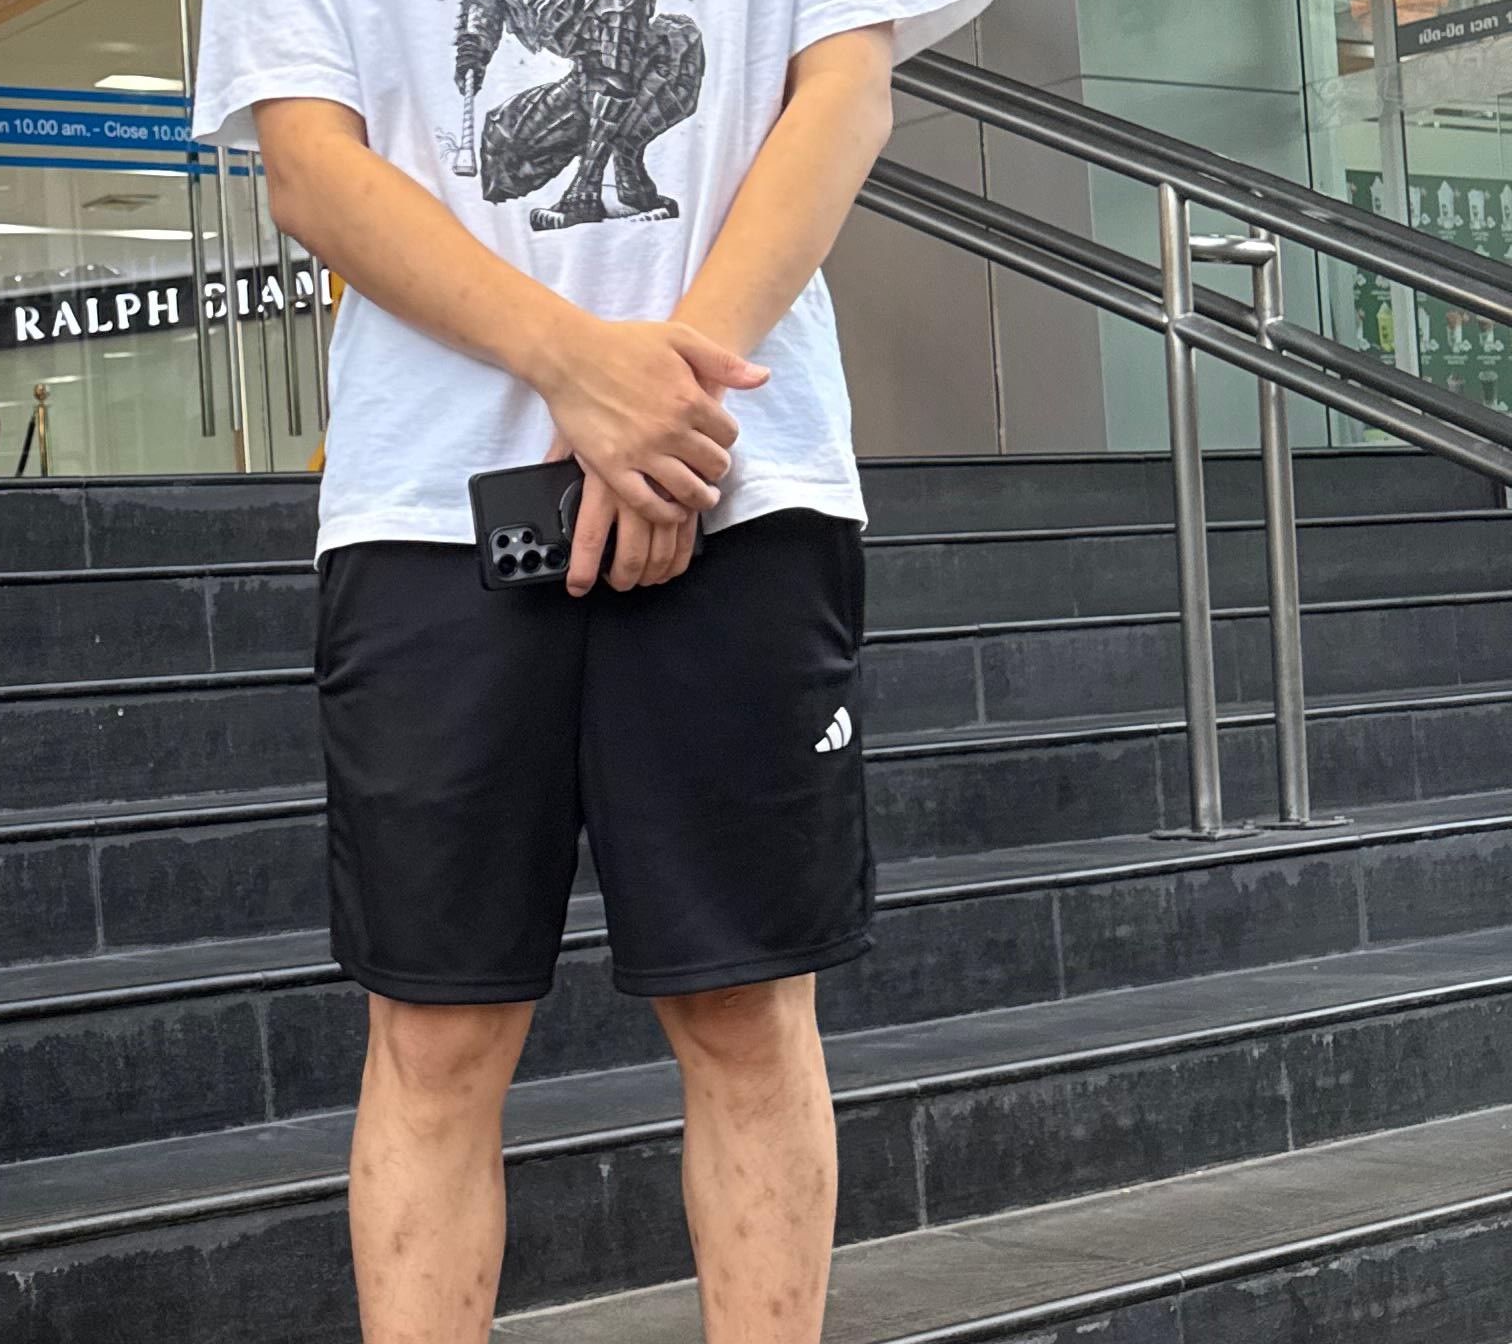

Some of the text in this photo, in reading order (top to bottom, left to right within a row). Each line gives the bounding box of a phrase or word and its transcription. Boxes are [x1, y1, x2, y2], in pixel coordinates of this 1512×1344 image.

[13, 118, 58, 137] 10.00
[61, 124, 91, 137] am.
[104, 121, 148, 140] Close
[14, 287, 180, 342] RALPH
